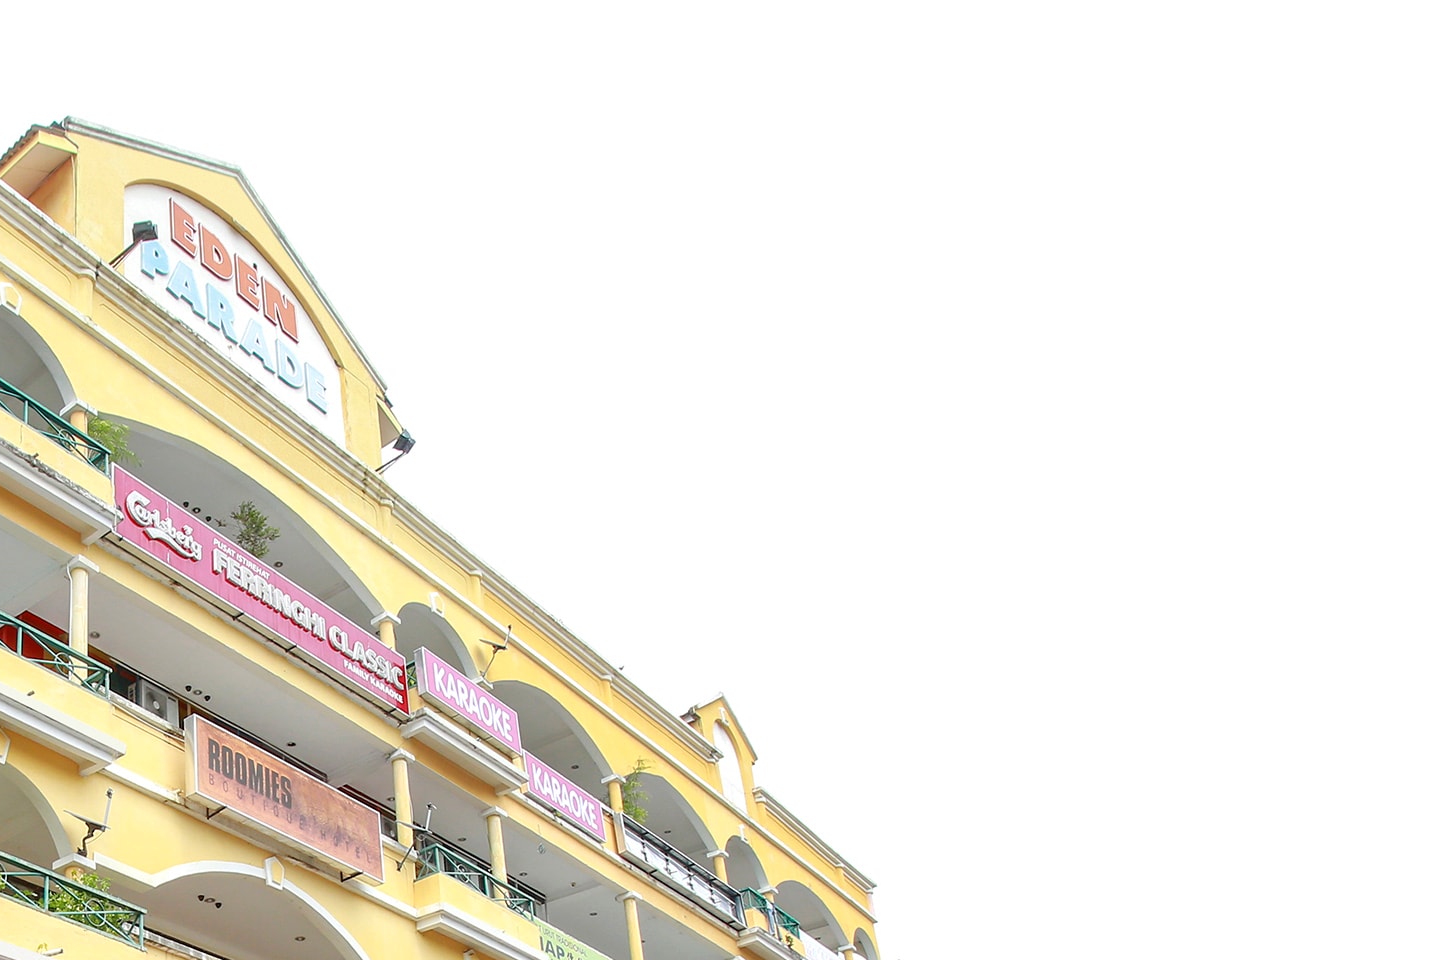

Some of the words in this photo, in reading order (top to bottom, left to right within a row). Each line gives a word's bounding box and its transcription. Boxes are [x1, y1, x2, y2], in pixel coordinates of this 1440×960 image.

[169, 197, 299, 344] EDEN
[140, 239, 328, 415] PARADE
[125, 490, 203, 563] Carlsberg
[212, 537, 236, 559] PUSAT
[235, 552, 271, 580] ISTIREHAT
[211, 547, 327, 643] FERRINGHI
[327, 624, 405, 692] CLASSIC
[342, 659, 371, 684] FAMILY
[370, 673, 404, 704] KARAOKE
[433, 662, 513, 742] KARAOKE
[207, 737, 293, 809] ROOMIES
[531, 763, 599, 831] KARAOKE
